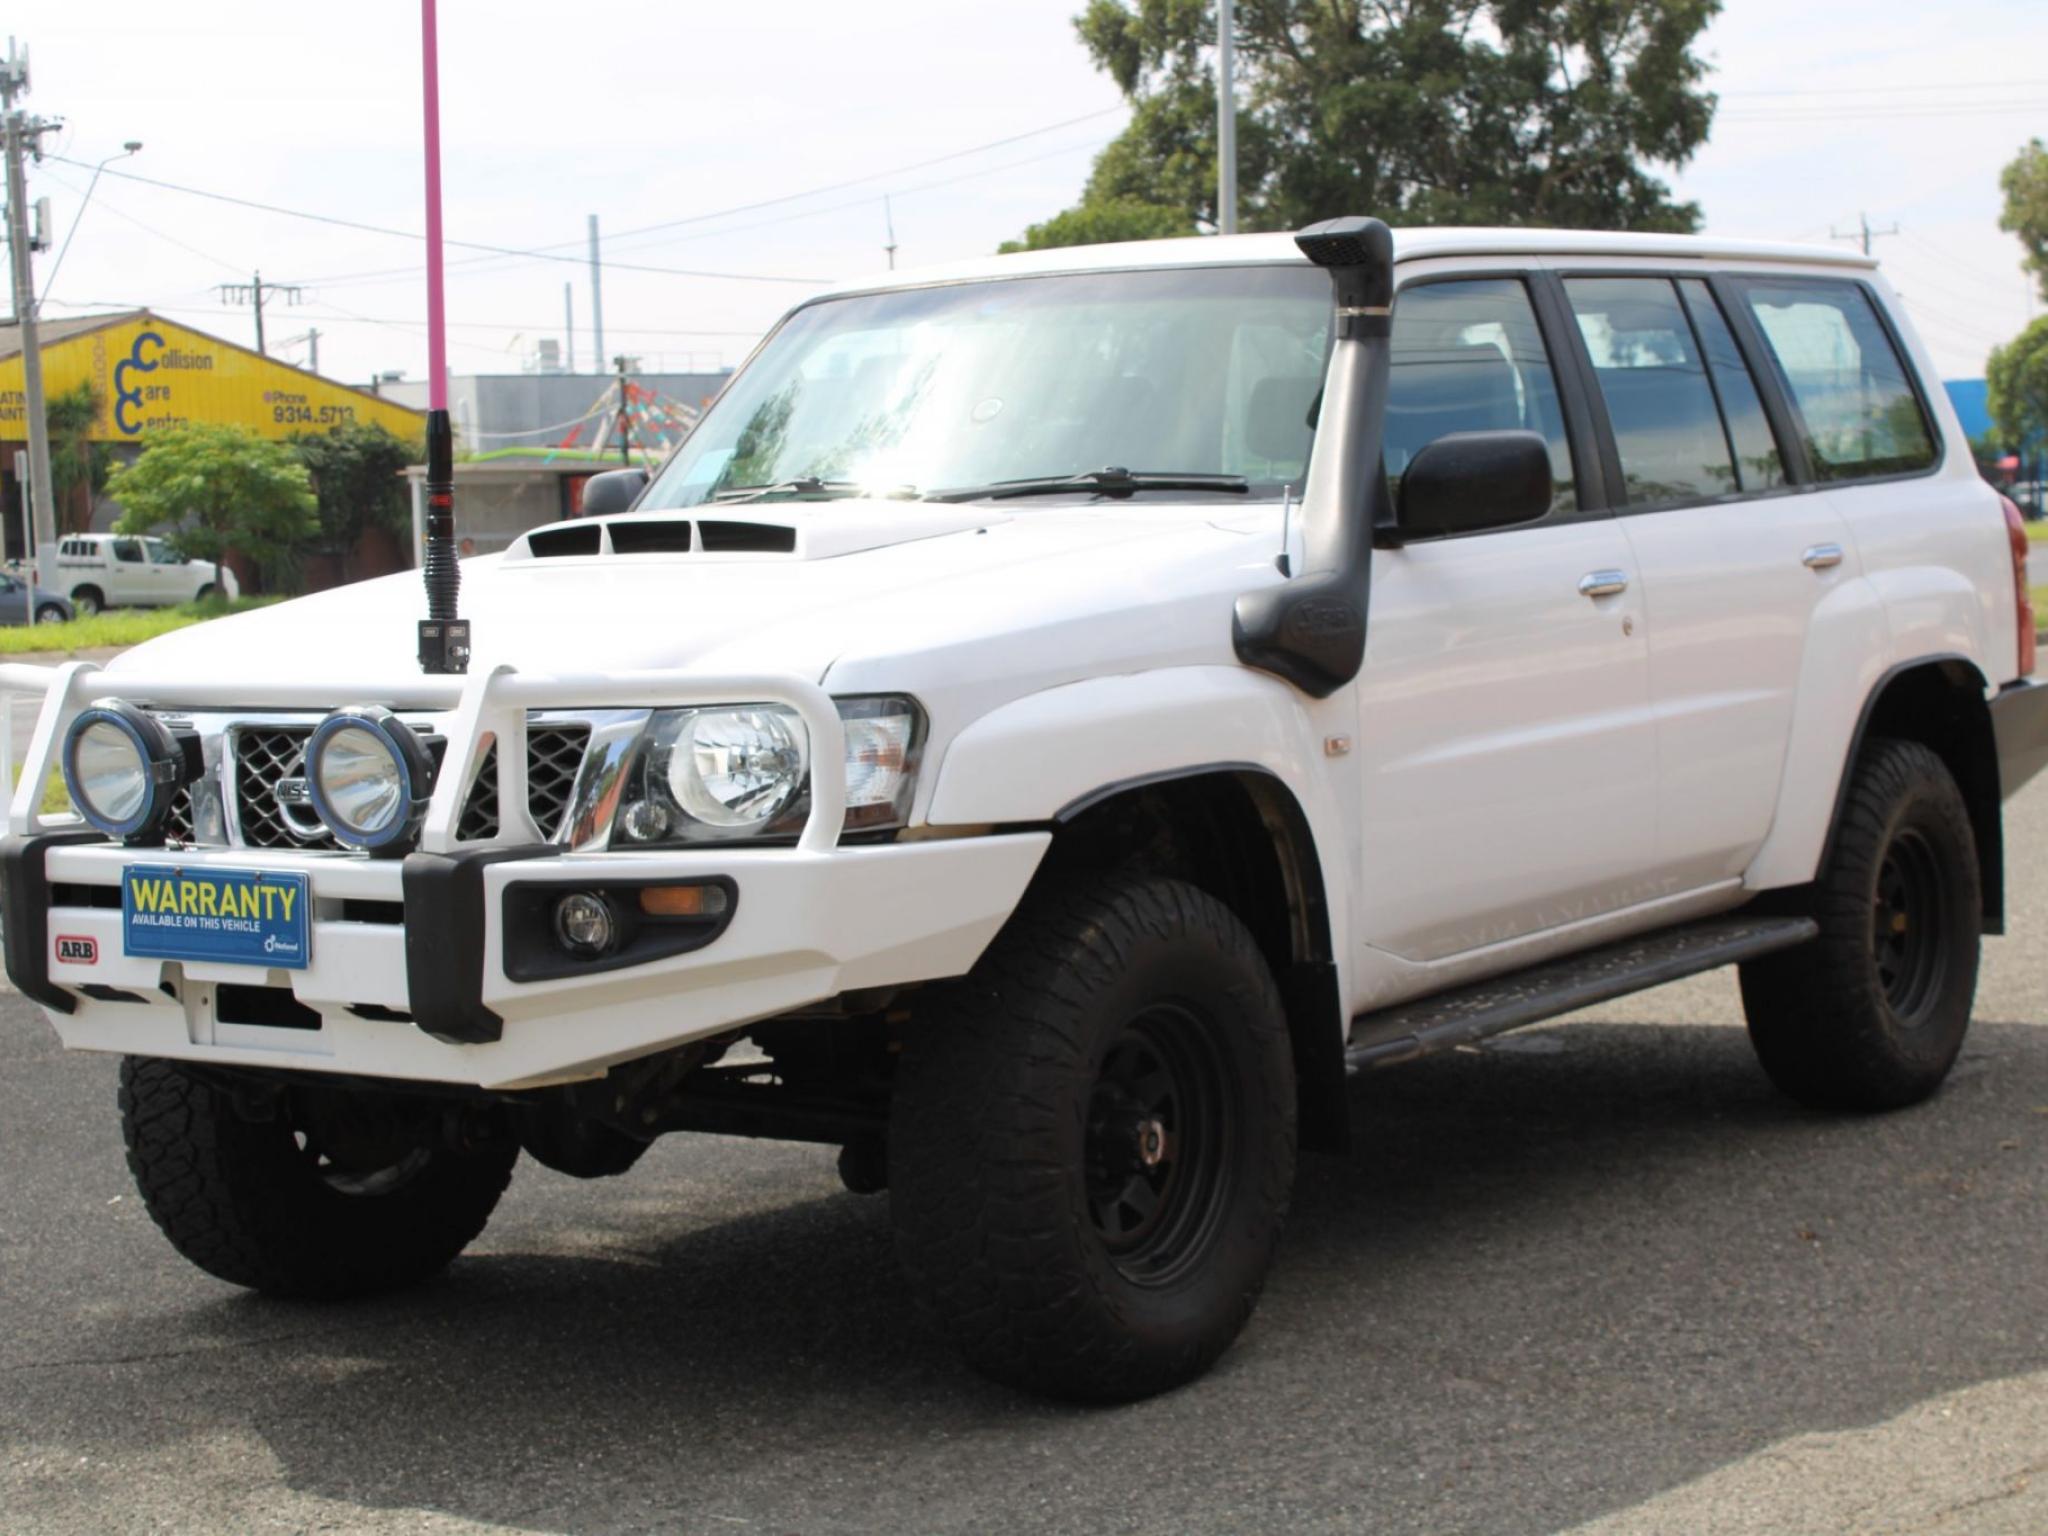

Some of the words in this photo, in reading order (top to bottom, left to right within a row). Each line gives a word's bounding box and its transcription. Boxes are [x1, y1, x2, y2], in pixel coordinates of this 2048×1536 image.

[131, 332, 213, 371] Collision
[273, 391, 307, 404] Phone
[131, 878, 296, 922] WARRANTY
[132, 913, 182, 927] AVAILABLE
[184, 917, 197, 928] ON
[199, 917, 220, 930] THIS
[222, 919, 261, 933] VEHICLE
[61, 941, 93, 959] ARB
